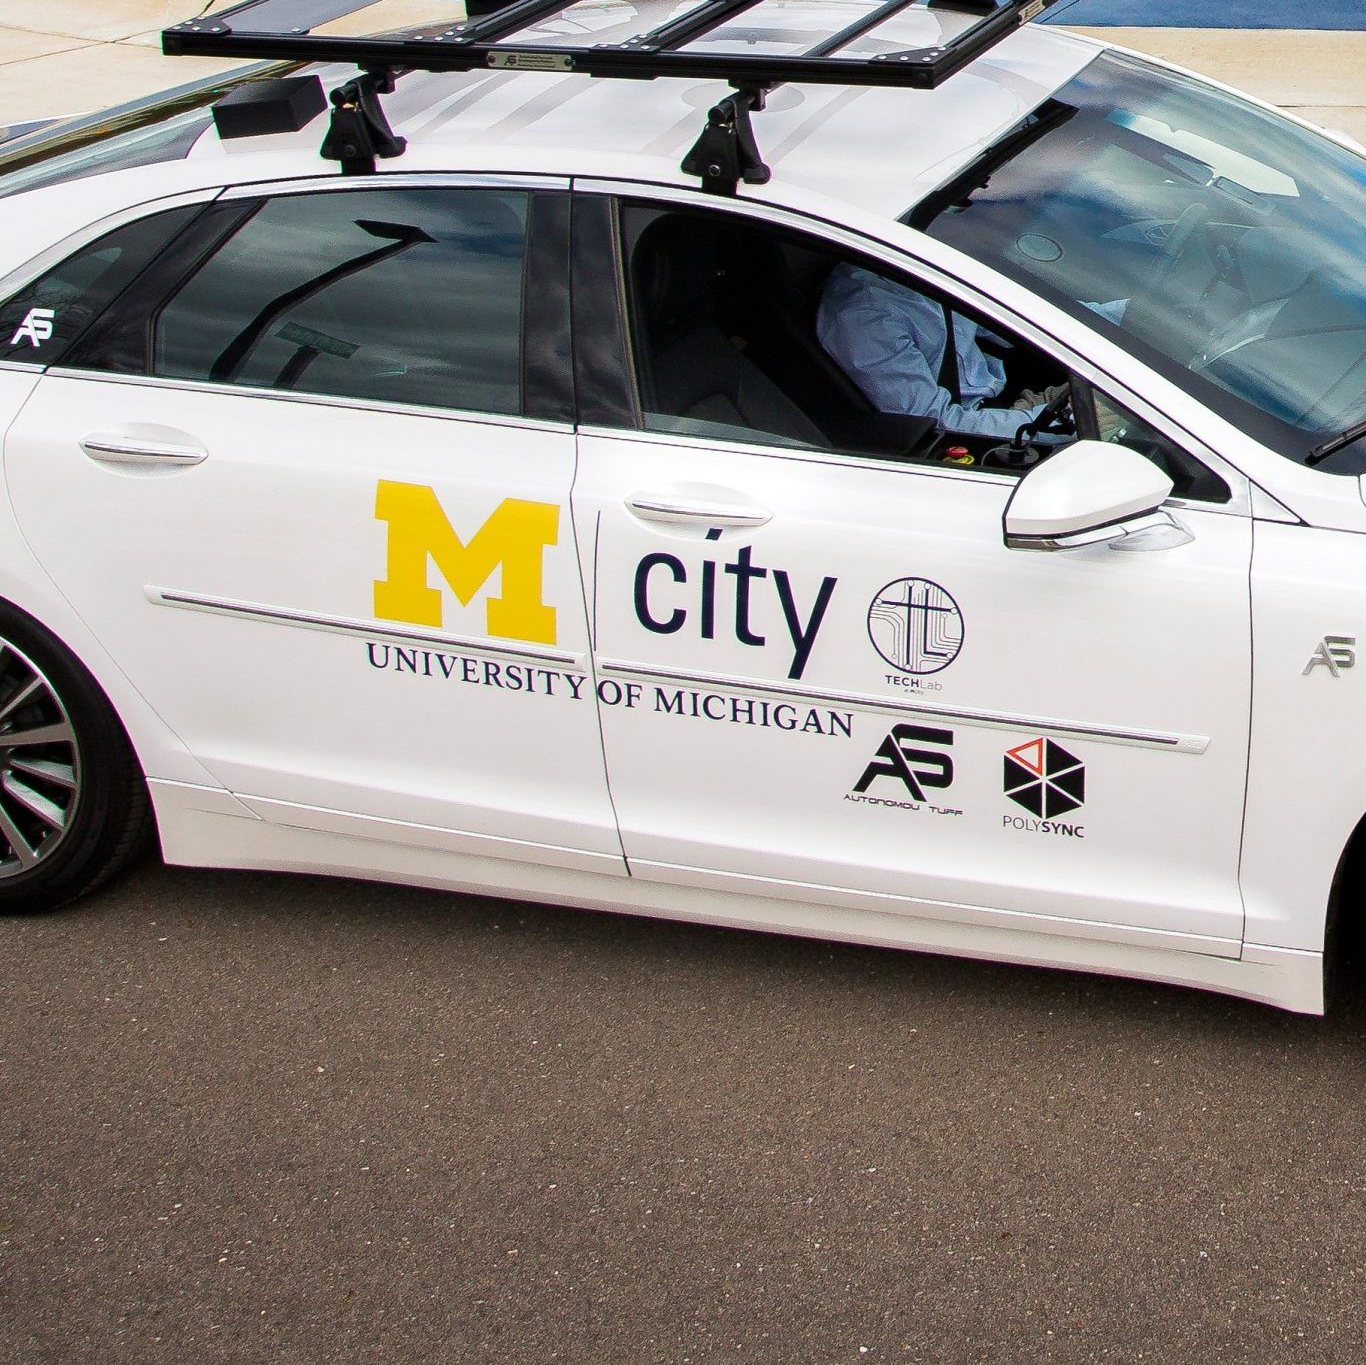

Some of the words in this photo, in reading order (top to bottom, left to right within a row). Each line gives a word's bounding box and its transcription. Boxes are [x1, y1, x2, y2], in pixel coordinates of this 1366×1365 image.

[373, 479, 560, 645] M
[633, 527, 838, 680] city
[366, 642, 588, 700] UNIVERSITY
[597, 679, 643, 708] OF
[653, 687, 854, 738] MICHIGAN
[1002, 815, 1085, 838] POLYSYNC
